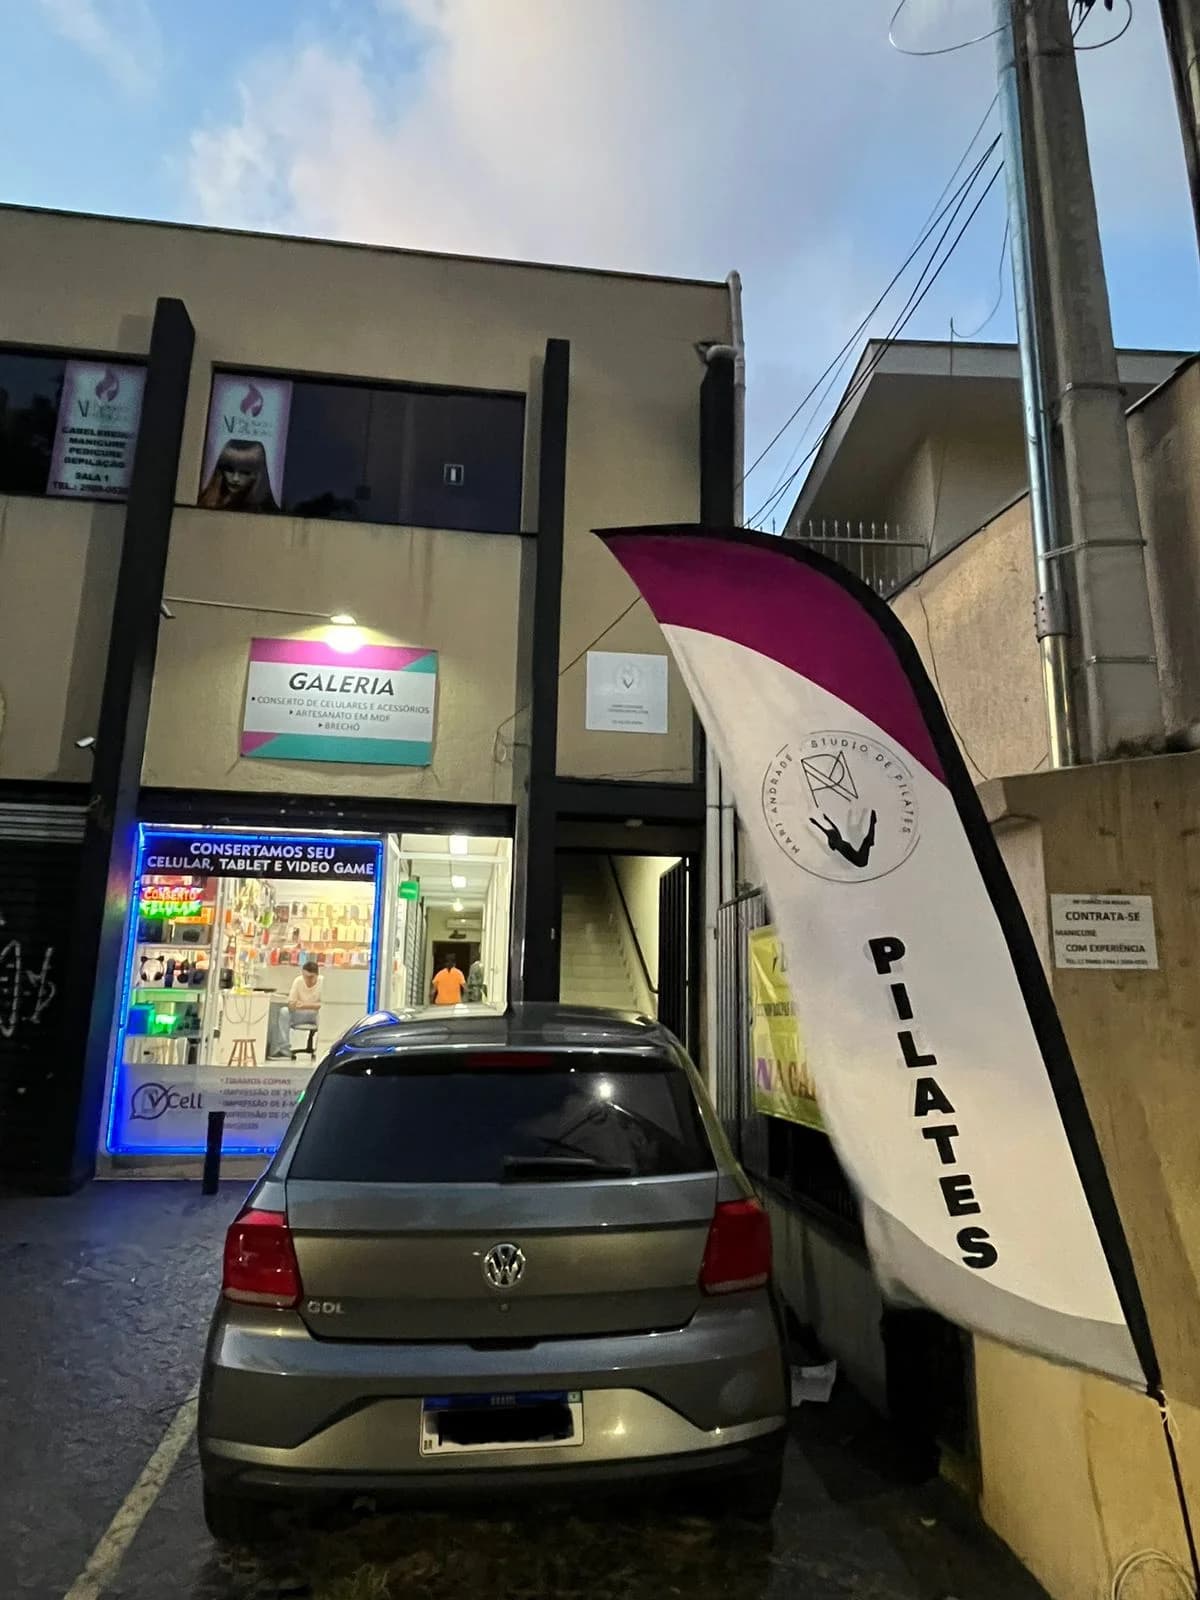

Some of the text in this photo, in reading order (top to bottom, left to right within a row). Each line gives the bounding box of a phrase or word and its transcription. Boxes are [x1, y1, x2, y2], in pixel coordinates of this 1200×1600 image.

[75, 472, 101, 481] SALA
[288, 672, 394, 696] GALERIA
[257, 696, 305, 706] CONSERTO
[306, 699, 319, 707] DE
[320, 700, 368, 710] CELULARES
[377, 704, 430, 714] ACESSÓRIOS
[295, 709, 391, 722] ARTESANATO EM MDF
[324, 722, 361, 732] BRECHÓ
[769, 754, 793, 814] ANDRADE
[810, 737, 915, 834] STUDIO DE PILATES
[190, 842, 335, 859] CONSERTAMOS SEU
[147, 856, 374, 875] CELULAR, TABLET E VIDEO GAME
[1065, 911, 1141, 922] CONTRATA-SE
[1065, 944, 1088, 953] COM
[868, 936, 998, 1269] PILATES
